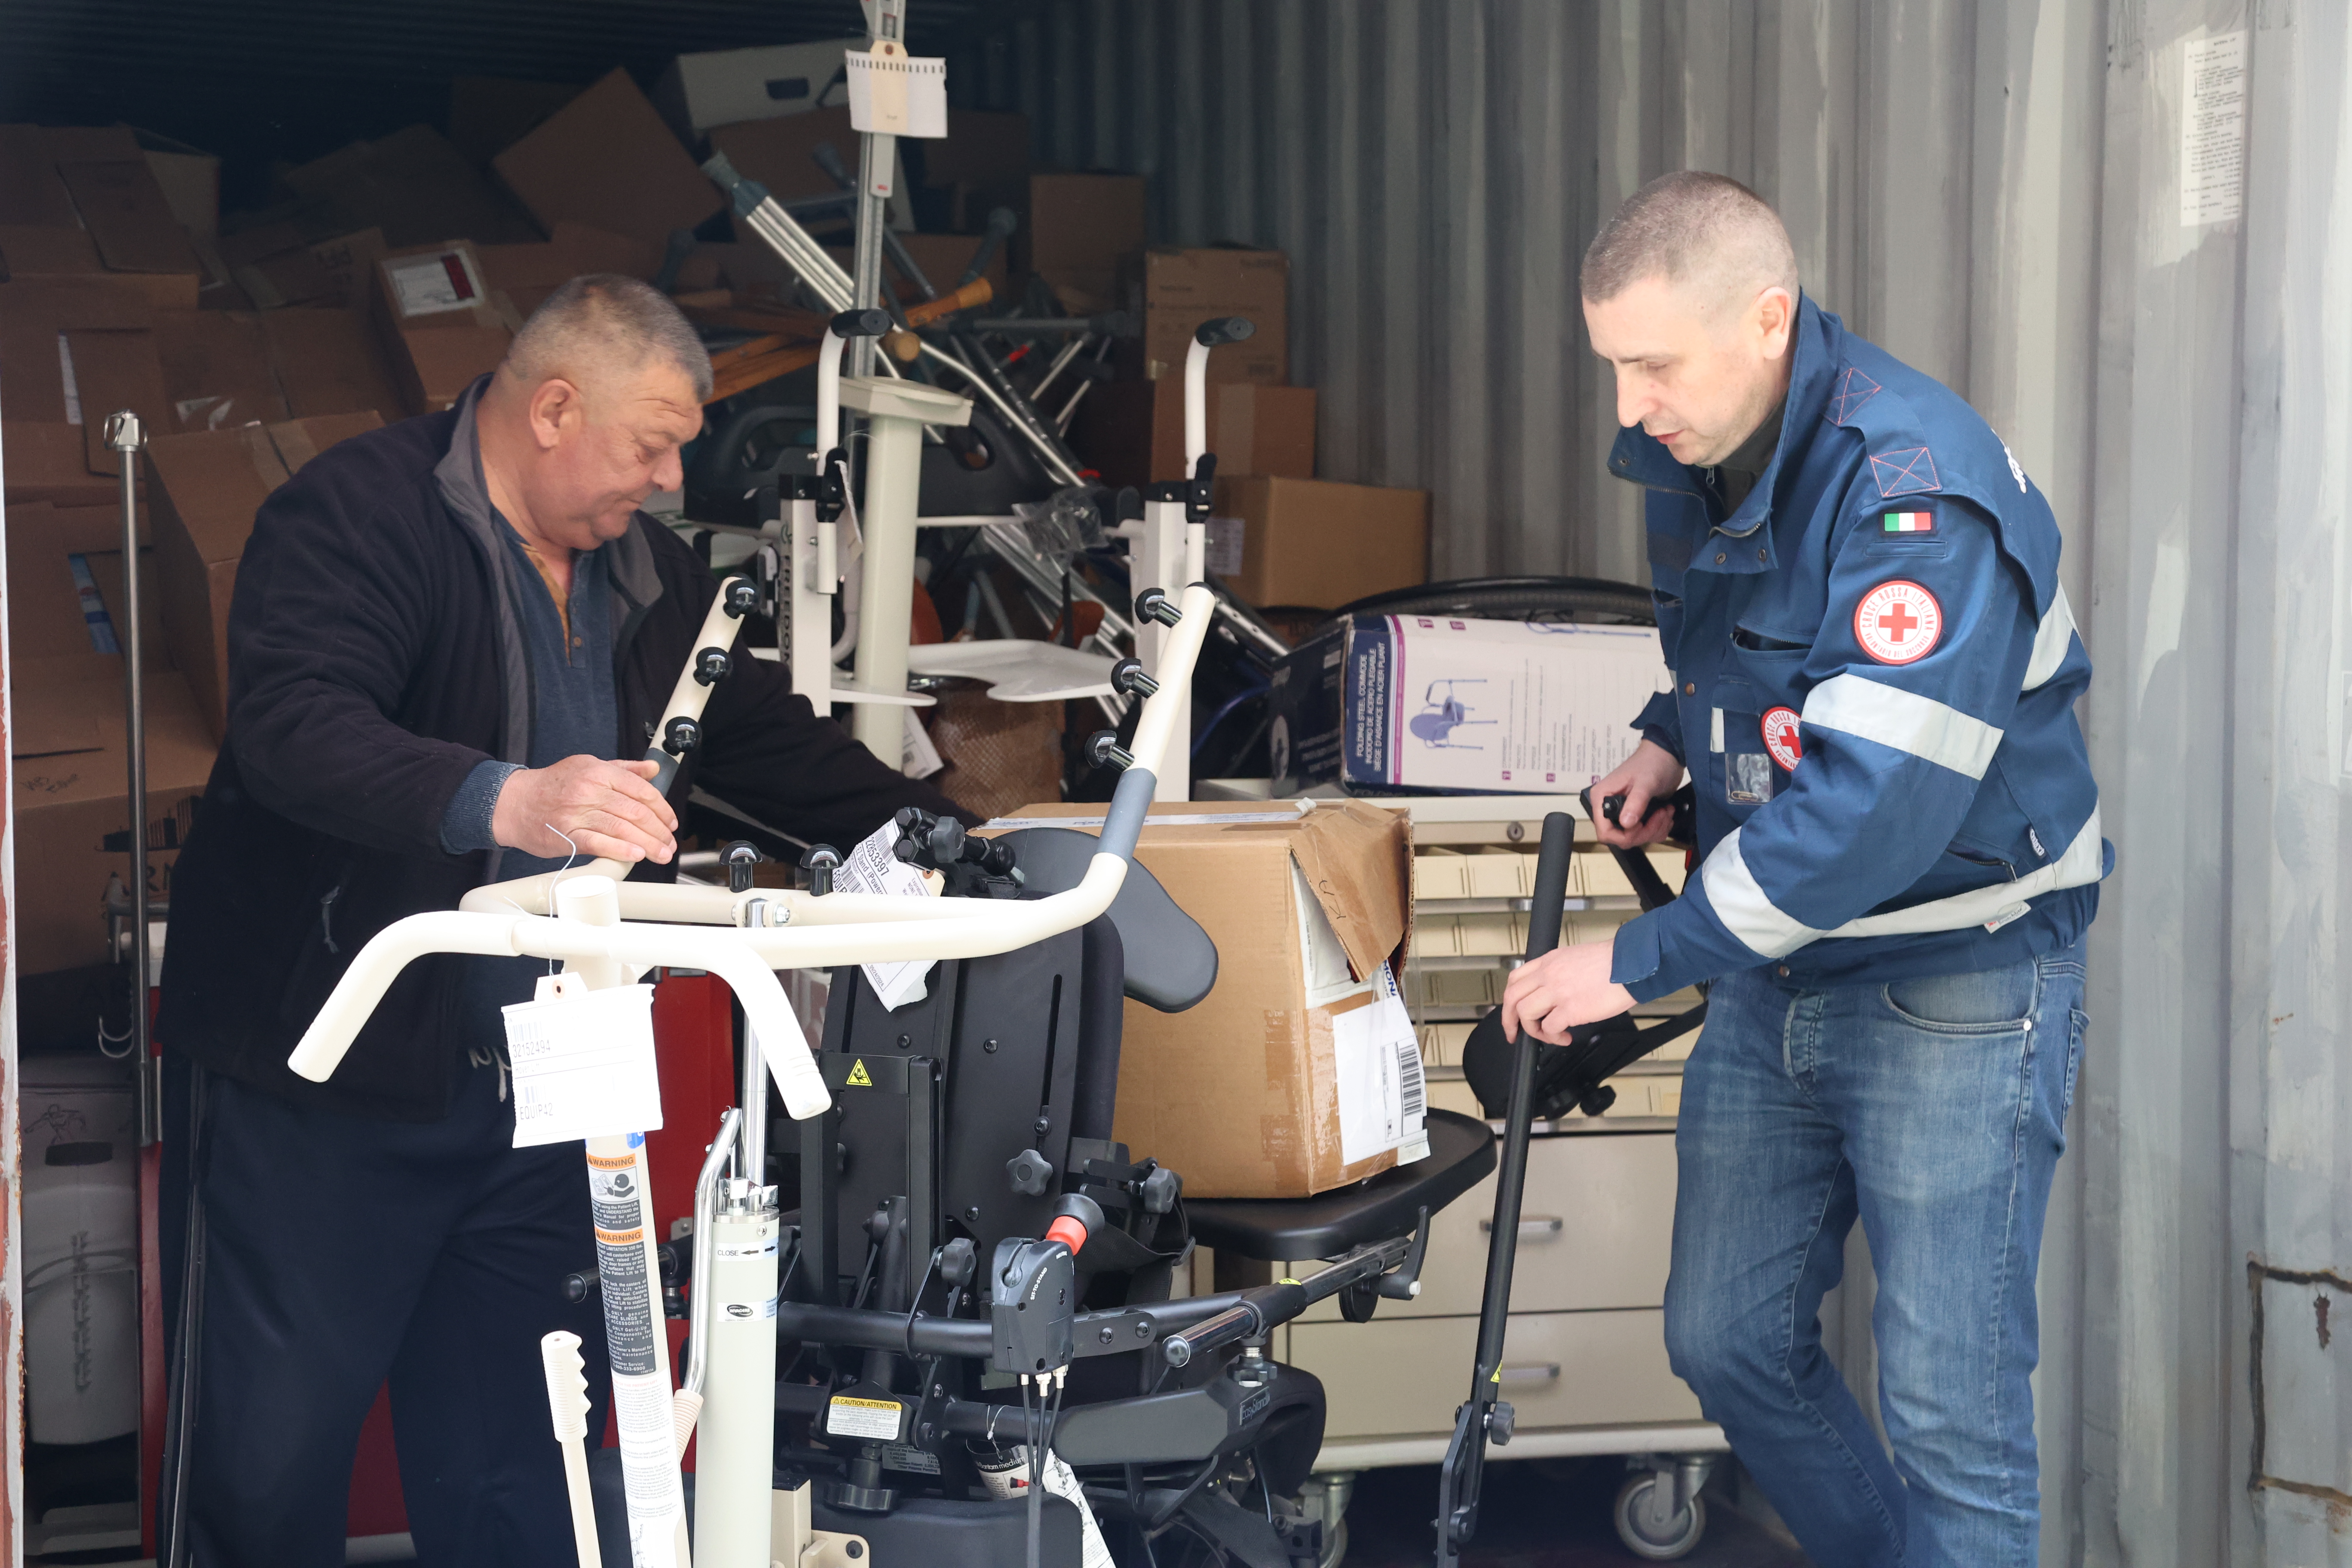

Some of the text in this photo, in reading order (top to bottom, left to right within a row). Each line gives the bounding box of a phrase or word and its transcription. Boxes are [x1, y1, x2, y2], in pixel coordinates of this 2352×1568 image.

[1862, 587, 1935, 630] CROCE ROSSA ITALIANA
[1865, 633, 1891, 657] VOLONTARIO
[1906, 635, 1929, 656] SOCCORSO
[1358, 654, 1367, 697] COMMODE
[1767, 712, 1791, 746] CROCE ROSSA
[1356, 722, 1365, 757] FOLDING
[1365, 727, 1373, 765] INODORO
[855, 846, 862, 854] EZ
[865, 836, 889, 876] 22853397
[857, 855, 869, 872] Stand
[870, 965, 884, 987] 09/24/2024
[513, 1039, 551, 1058] 32152494
[520, 1102, 553, 1120] EQUIP42
[593, 1157, 634, 1167] WARNING
[600, 1231, 641, 1242] WARNING
[1056, 1251, 1067, 1259] NEUTRAL
[1030, 1267, 1047, 1300] SIT-TO-STAND
[612, 1358, 627, 1366] Customer
[613, 1363, 646, 1371] 1-800-333-6900
[840, 1399, 897, 1409] CAUTION/ATTENTION
[999, 1456, 1026, 1469] medium
